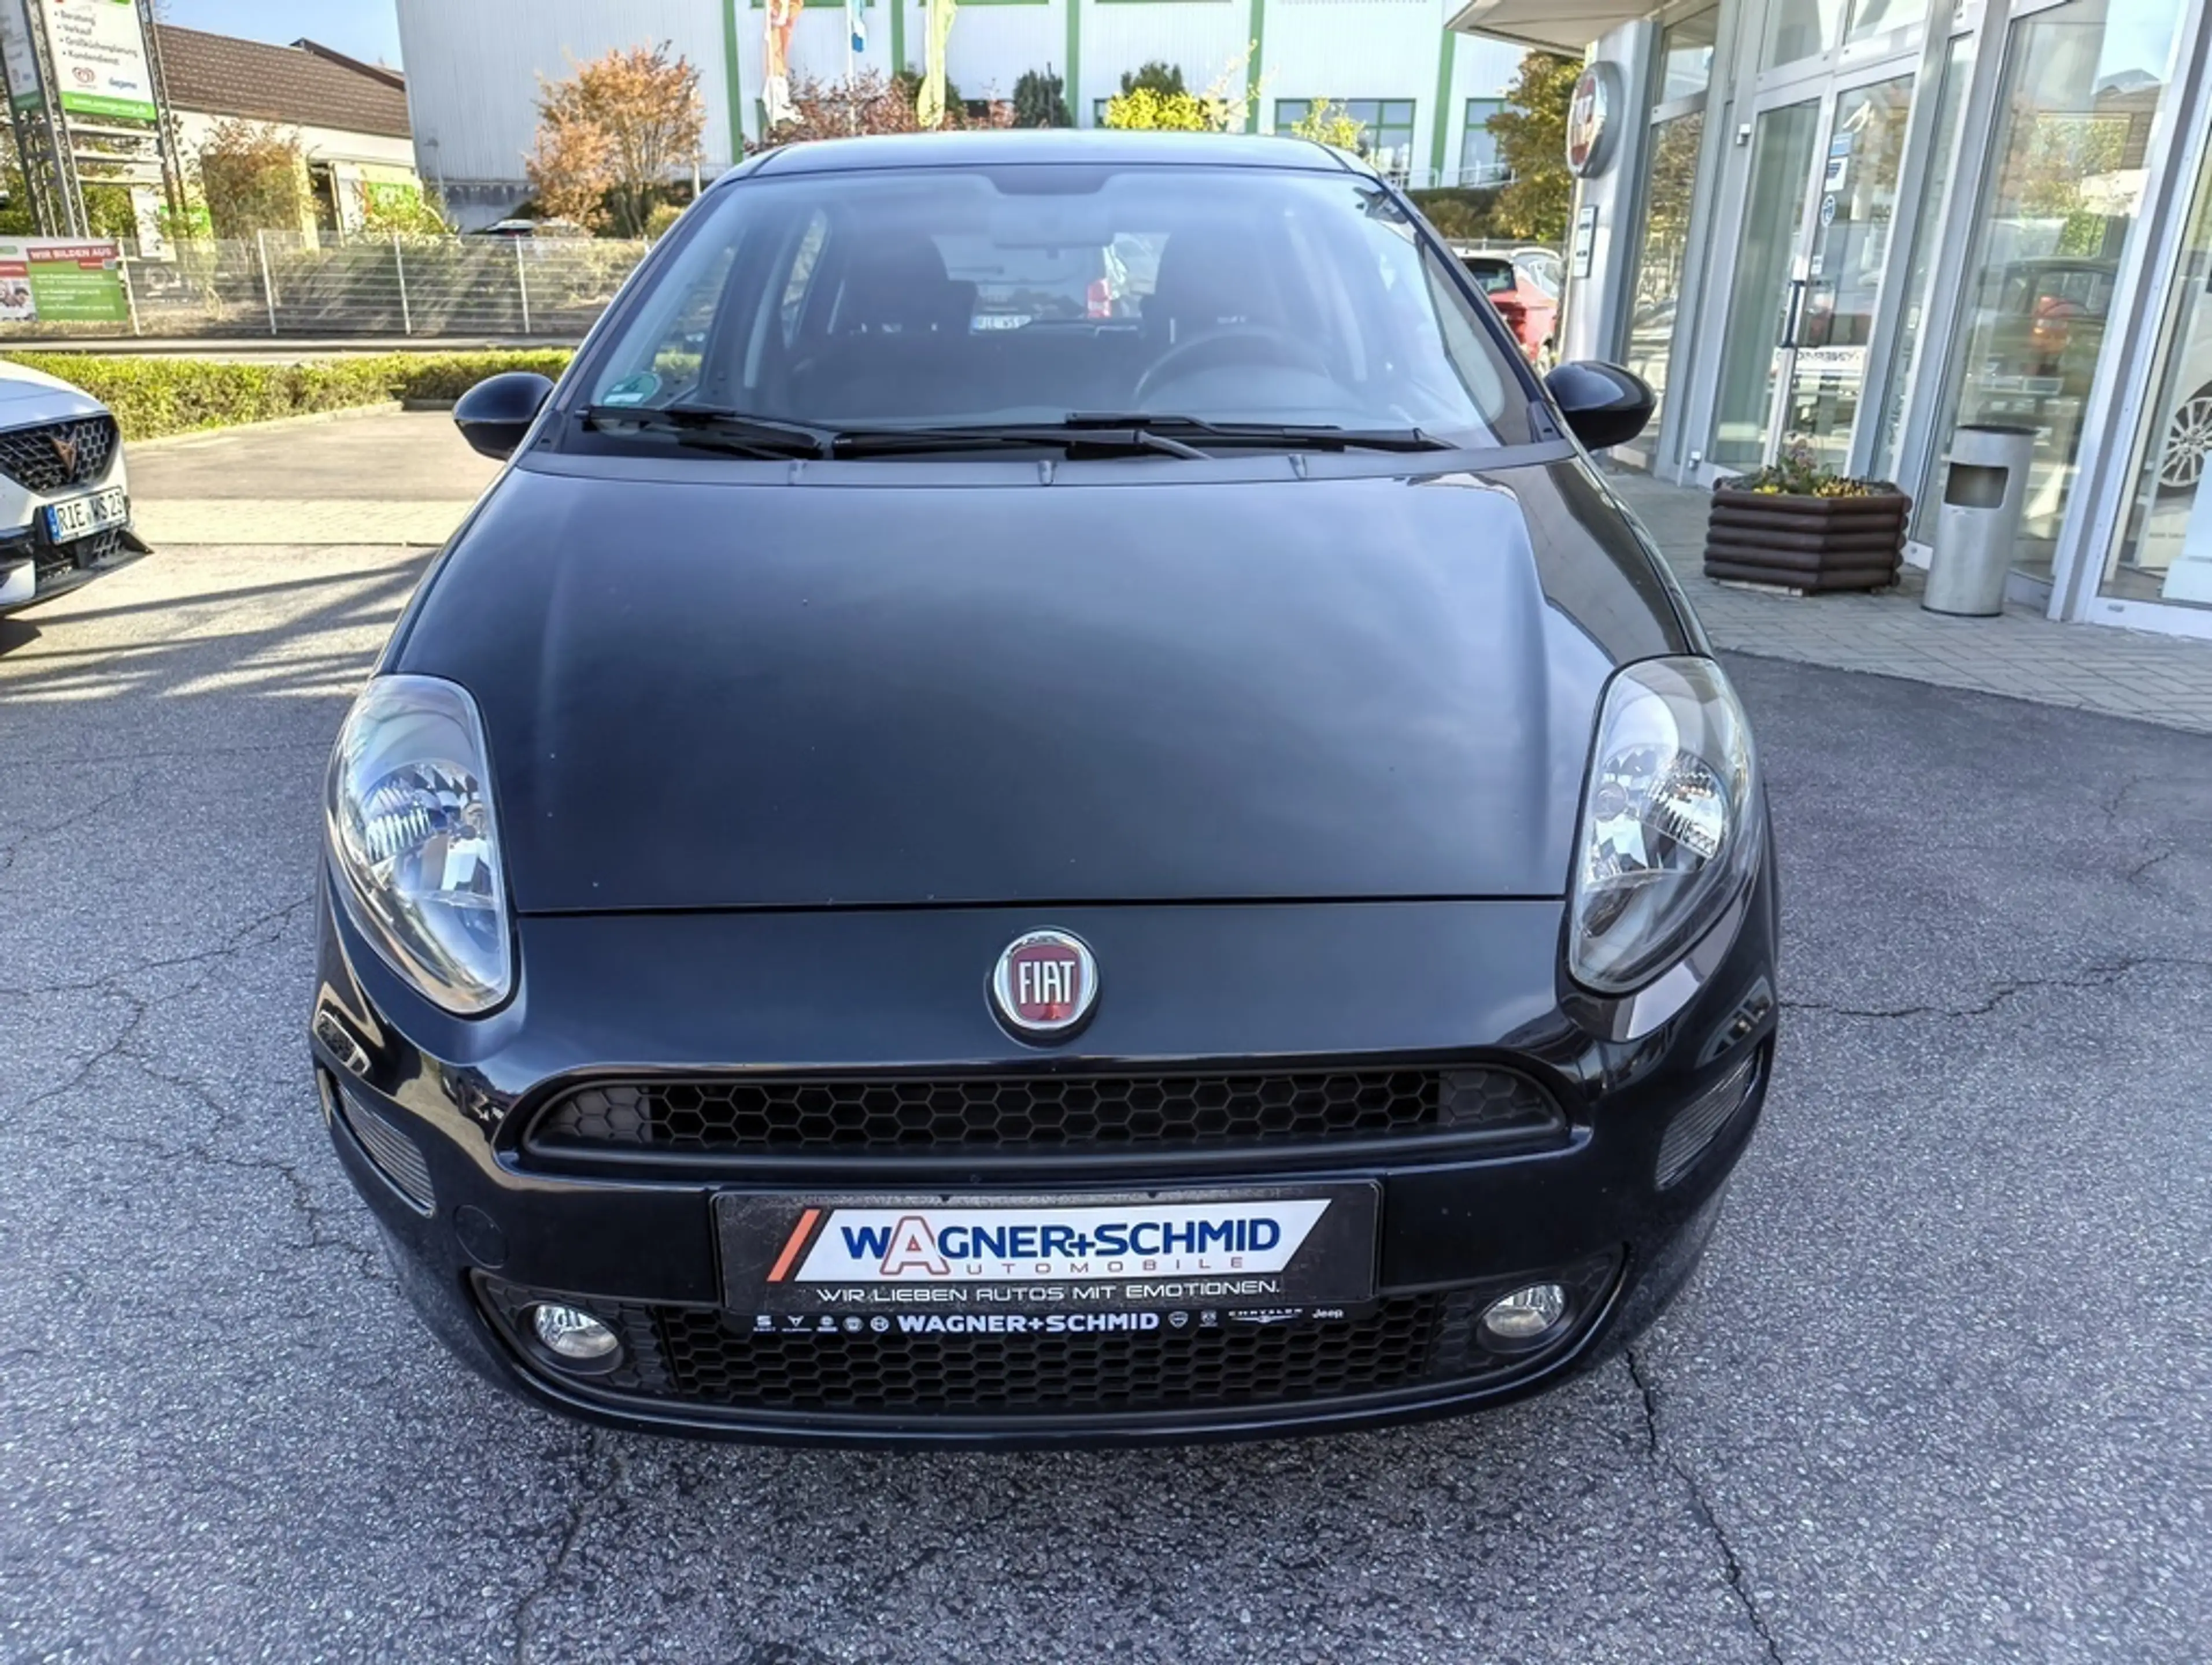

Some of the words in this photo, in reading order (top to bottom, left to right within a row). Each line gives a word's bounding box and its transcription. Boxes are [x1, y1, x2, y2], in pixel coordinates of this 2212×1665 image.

[31, 249, 51, 259] WIR
[53, 249, 90, 258] BILDEN
[92, 247, 112, 257] AUS
[57, 503, 86, 530] RIE
[1019, 961, 1075, 1004] FIAT
[841, 1216, 1281, 1275] WAGNER+SCHMID
[816, 1288, 864, 1302] WIR
[874, 1288, 968, 1303] LIEBEN
[976, 1286, 1064, 1301] AUTOS
[1072, 1285, 1116, 1299] MIT
[1126, 1280, 1280, 1298] EMOTIONEN.
[897, 1312, 1160, 1333] WAGNER+SCHMID
[1312, 1308, 1344, 1319] Jeep
